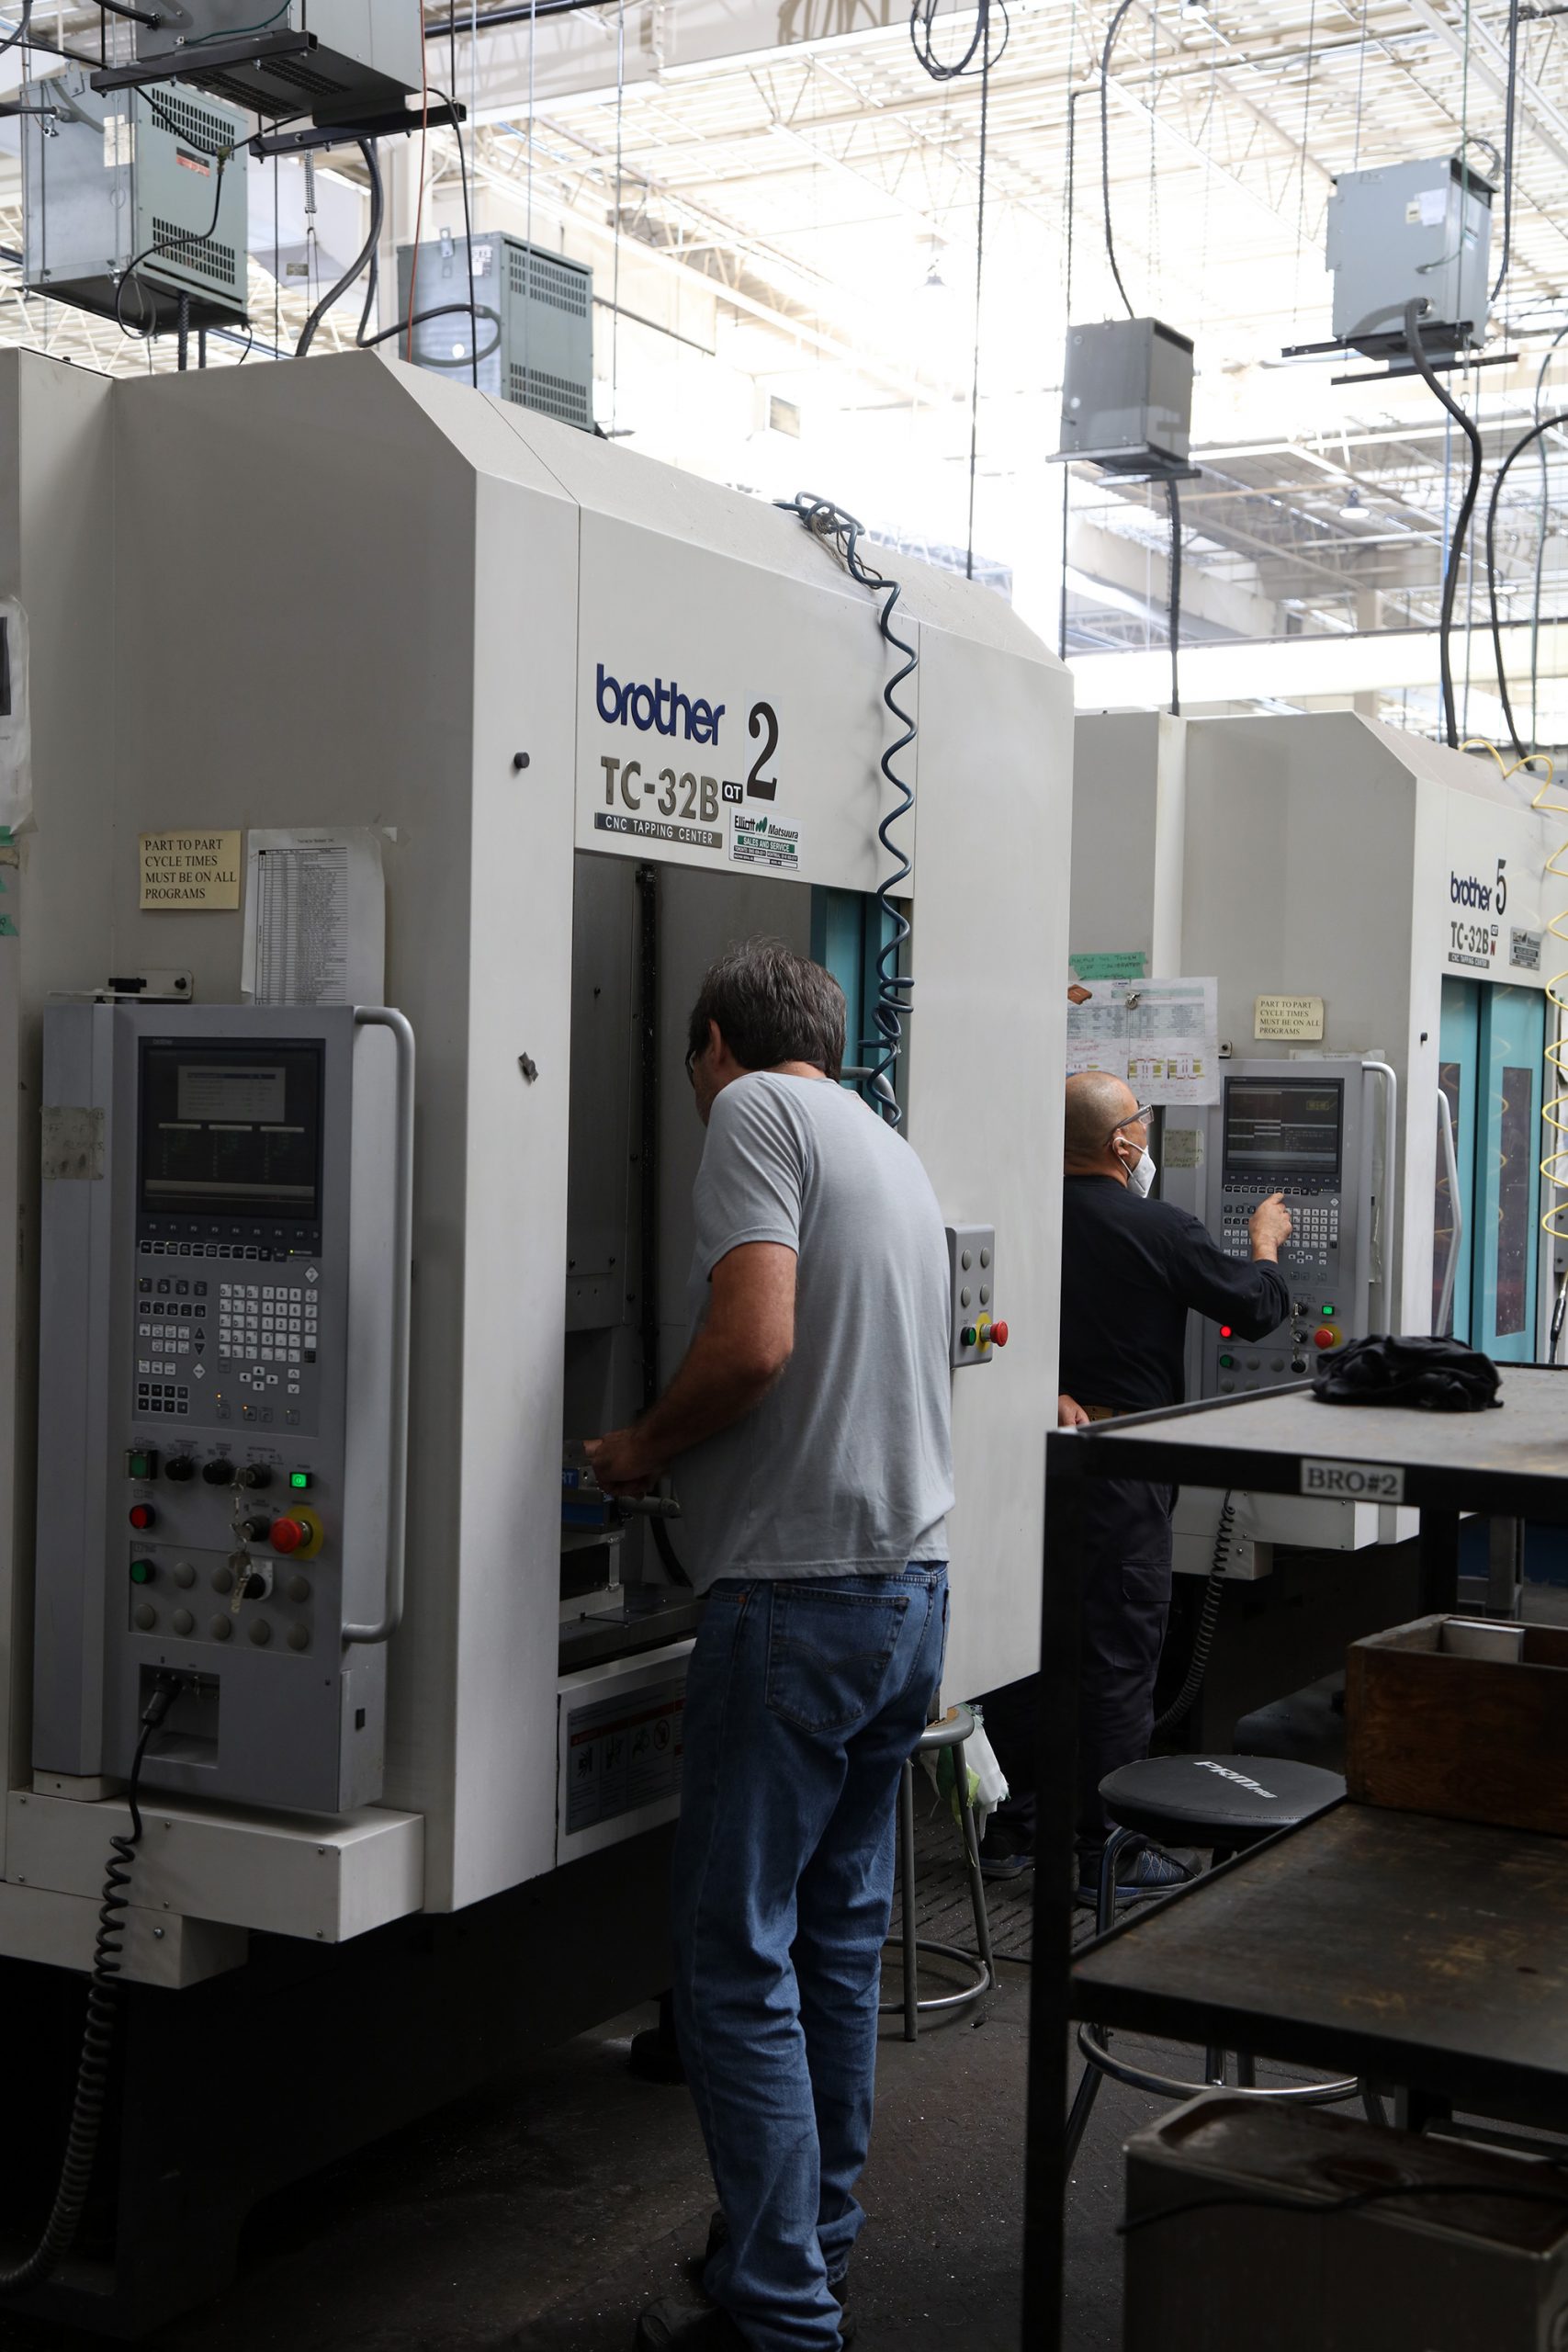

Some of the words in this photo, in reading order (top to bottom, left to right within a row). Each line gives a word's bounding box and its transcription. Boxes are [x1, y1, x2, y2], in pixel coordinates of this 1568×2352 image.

[596, 662, 726, 746] brother
[747, 701, 779, 801] 2
[601, 755, 719, 822] TC-32B
[724, 785, 741, 799] QT
[605, 816, 627, 831] CNC
[633, 820, 673, 838] TAPPING
[678, 828, 713, 844] CENTER
[735, 815, 755, 831] Elliott
[768, 824, 798, 839] Matsuura
[145, 840, 174, 851] PART
[176, 839, 192, 851] TO
[195, 839, 223, 850] PART
[743, 837, 759, 847] SALES
[760, 840, 769, 848] AND
[770, 842, 790, 853] SERVICE
[145, 855, 183, 867] CYCLE
[185, 855, 218, 866] TIMES
[146, 872, 176, 883] MUST
[179, 872, 193, 882] BE
[195, 871, 211, 883] ON
[214, 871, 237, 883] ALL
[1450, 871, 1492, 911] brother
[1495, 858, 1506, 915] 5
[145, 888, 206, 899] PROGRAMS
[1450, 921, 1489, 955] TC-32B
[1307, 1466, 1398, 1496] BRO#2
